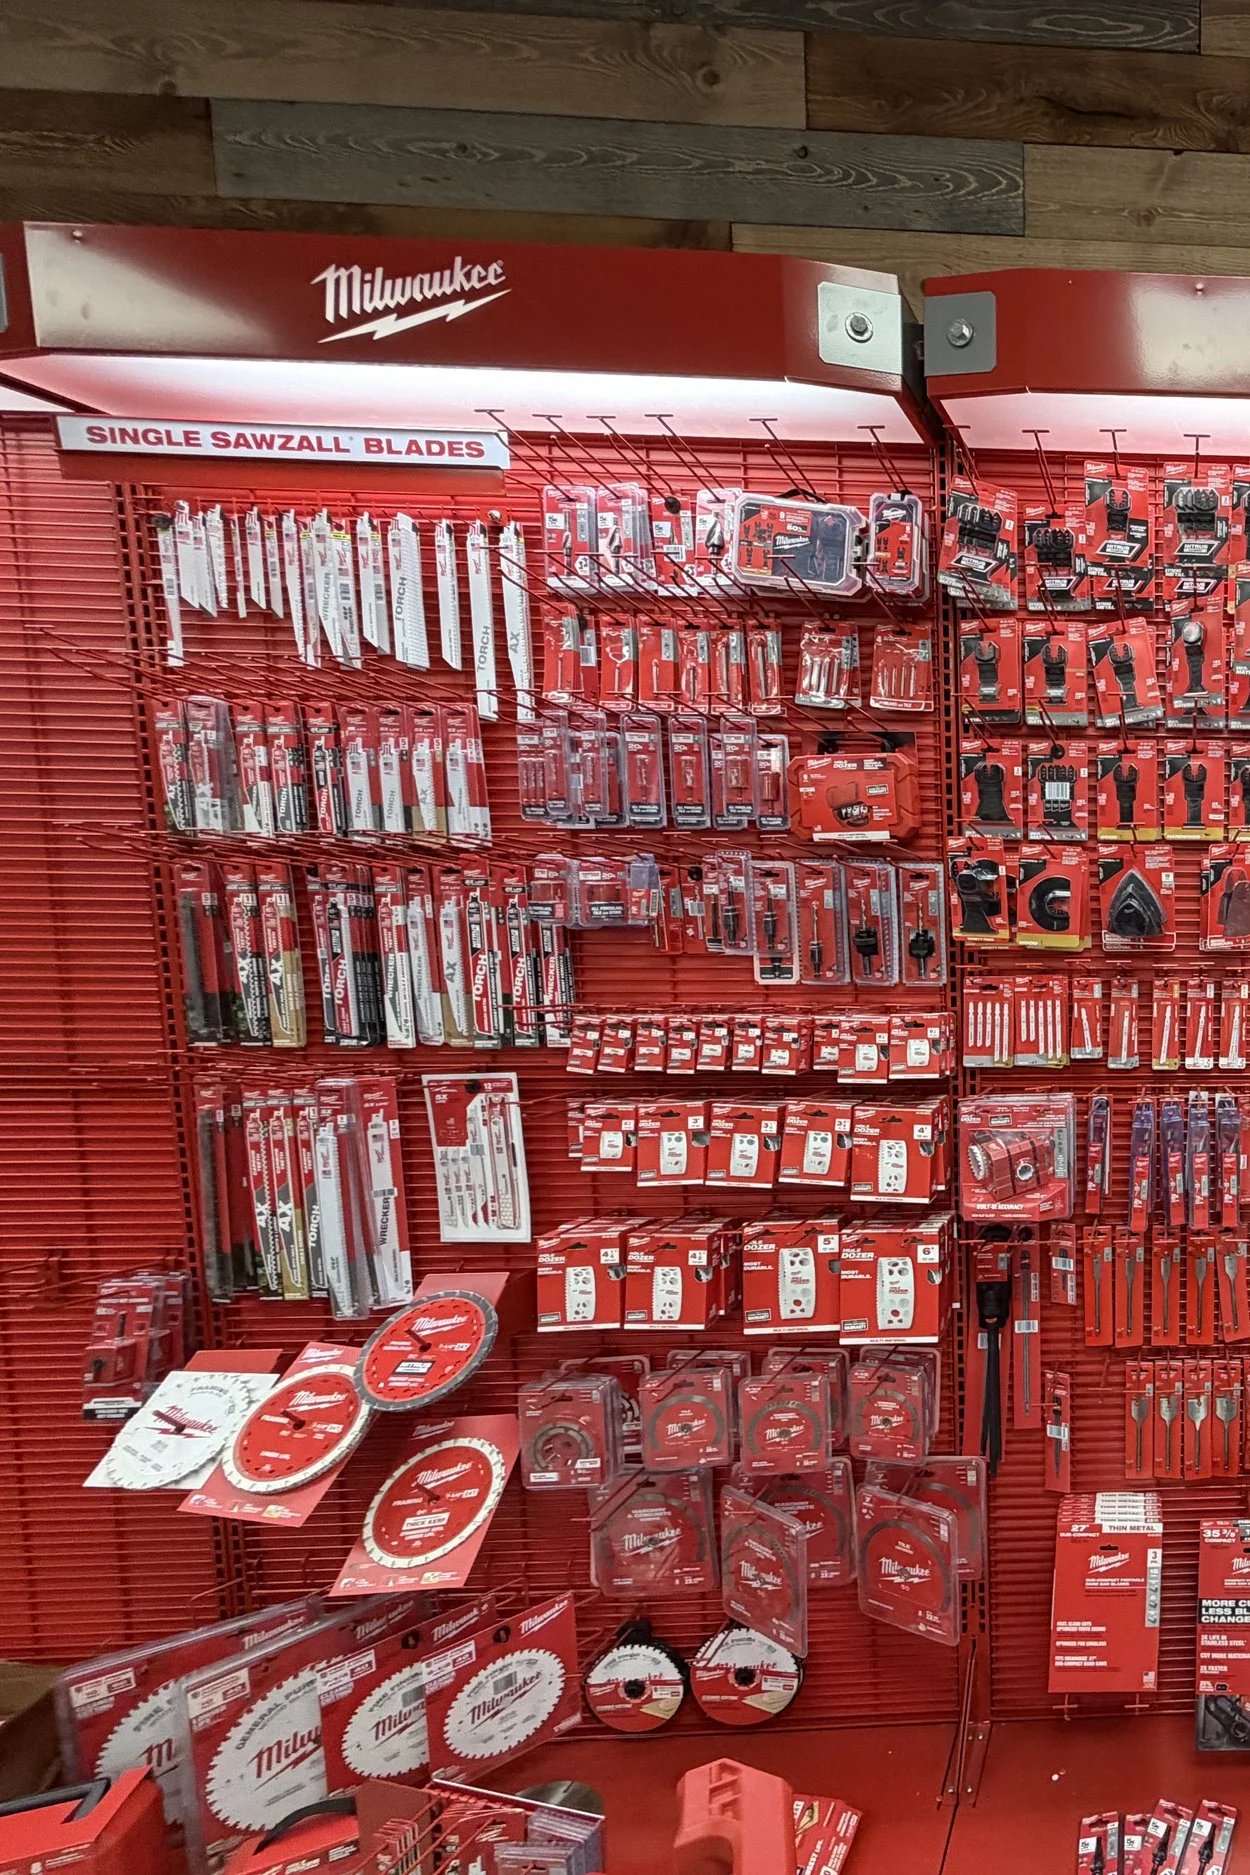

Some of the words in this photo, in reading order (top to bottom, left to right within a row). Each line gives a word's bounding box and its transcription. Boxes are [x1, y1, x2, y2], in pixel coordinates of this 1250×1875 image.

[310, 256, 506, 324] Milwaukee
[86, 425, 203, 448] SINGLE
[210, 431, 350, 454] SAWZALL
[364, 437, 486, 459] BLADES
[395, 576, 407, 621] TORCH
[477, 625, 491, 672] TORCH
[509, 631, 520, 654] AX
[279, 788, 288, 817] TORCH
[319, 788, 329, 818] TORCH
[355, 789, 363, 818] TORCH
[387, 790, 396, 819] TORCH
[420, 788, 429, 805] AX
[239, 958, 251, 984] AX
[270, 958, 283, 985] AX
[335, 958, 347, 1005] TORCH
[387, 953, 395, 998] WRECKER
[445, 961, 457, 983] AX
[473, 954, 488, 1001] TORCH
[514, 958, 525, 1002] TORCH
[548, 956, 556, 999] WRECKER
[256, 1202, 270, 1228] AX
[280, 1200, 293, 1232] AX
[309, 1205, 320, 1247] TORCH
[379, 1196, 391, 1245] WRECKER
[289, 1391, 350, 1406] Milwaukee
[412, 1461, 474, 1486] Milwaukee
[1203, 1529, 1221, 1537] 35
[1088, 1552, 1130, 1569] Milwaukee
[1151, 1551, 1158, 1559] 3
[519, 1600, 568, 1633] Milwaukee
[1201, 1599, 1236, 1608] MORE
[1201, 1608, 1232, 1616] LESS
[235, 1702, 282, 1750] GENERAL
